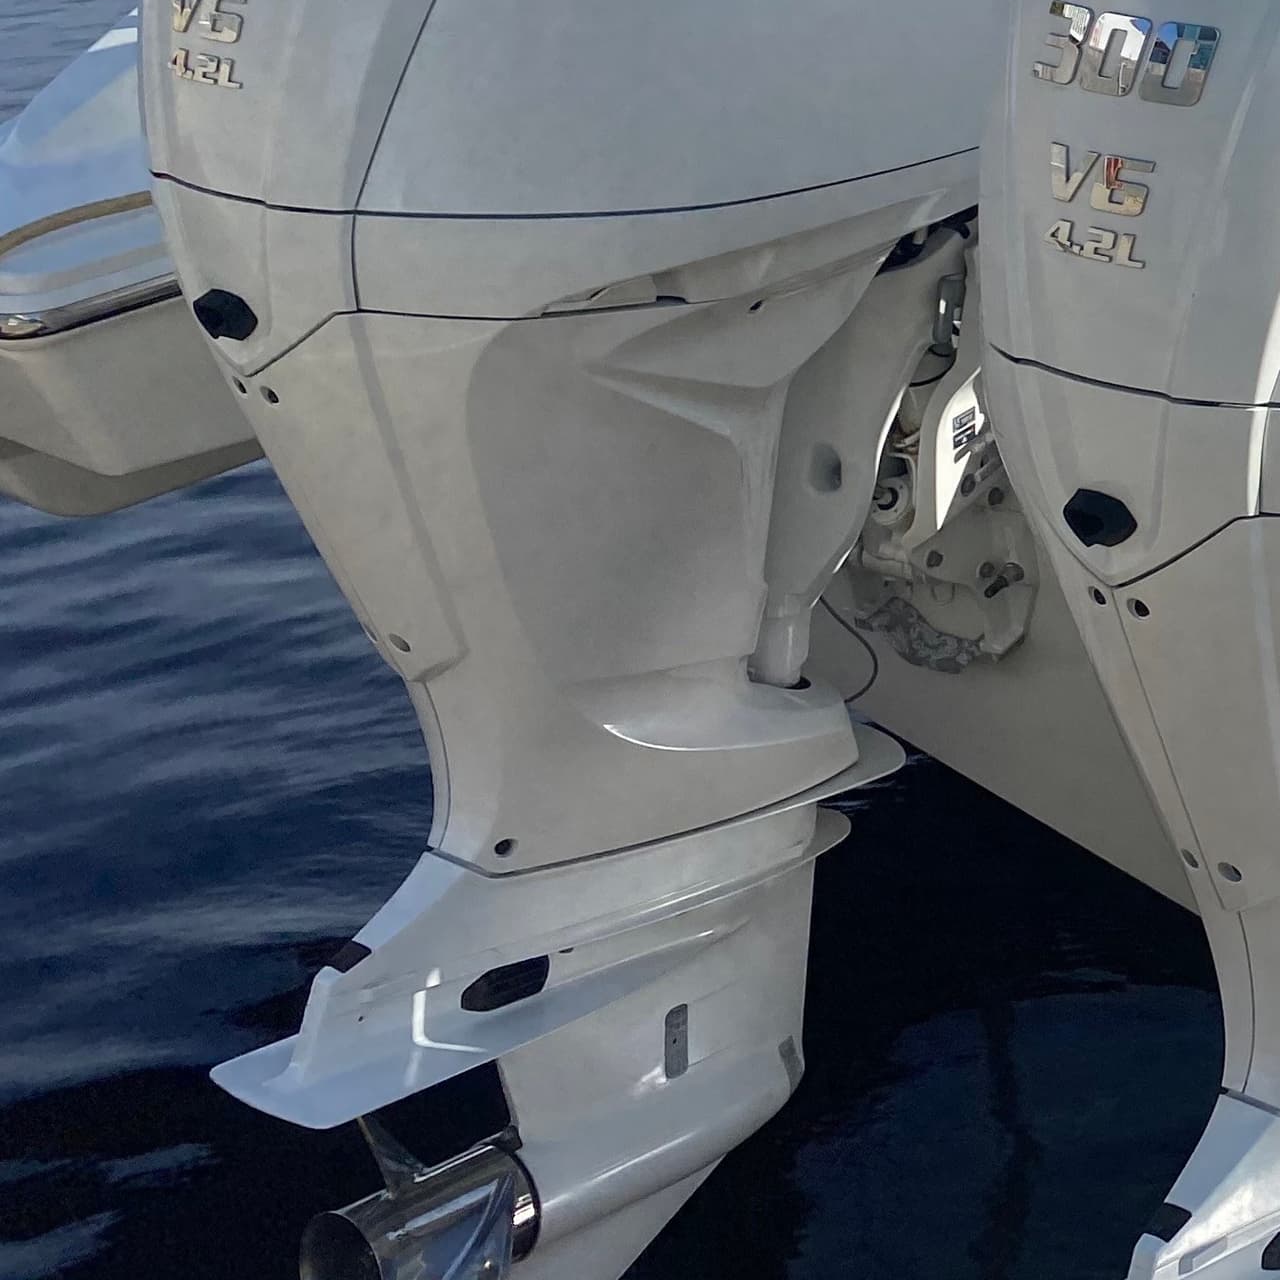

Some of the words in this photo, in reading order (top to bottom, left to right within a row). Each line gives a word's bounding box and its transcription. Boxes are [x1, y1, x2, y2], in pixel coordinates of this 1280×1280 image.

[167, 48, 243, 89] 4.2L
[1032, 0, 1222, 107] 300
[1048, 141, 1157, 217] V6
[1044, 219, 1145, 269] 4.2L
